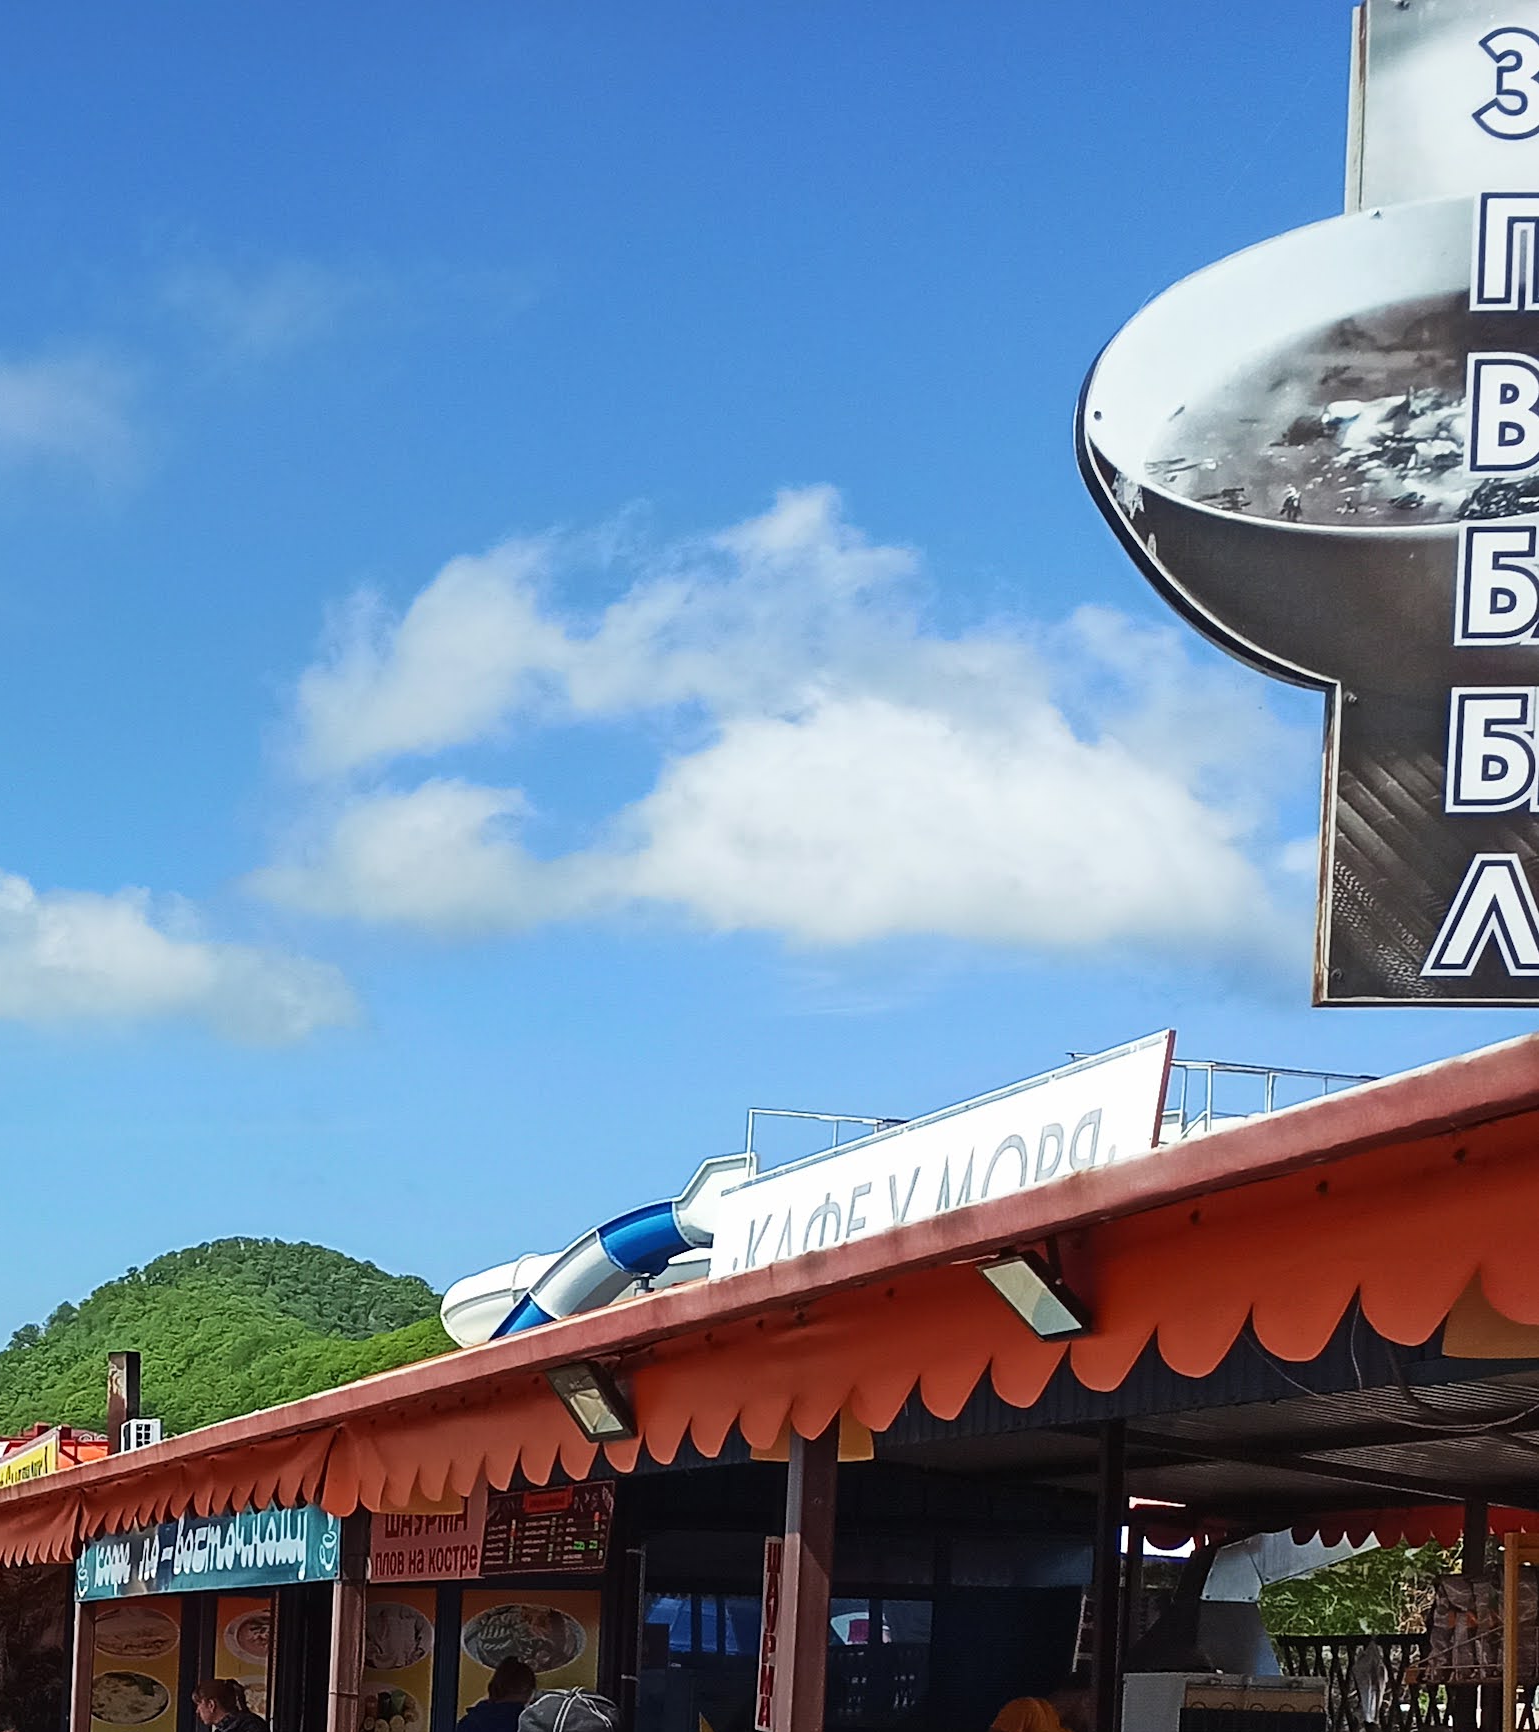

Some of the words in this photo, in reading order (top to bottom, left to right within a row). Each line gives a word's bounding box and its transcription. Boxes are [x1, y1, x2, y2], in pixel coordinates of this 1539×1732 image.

[375, 1550, 405, 1577] плов
[408, 1548, 425, 1575] на
[428, 1544, 479, 1578] костре
